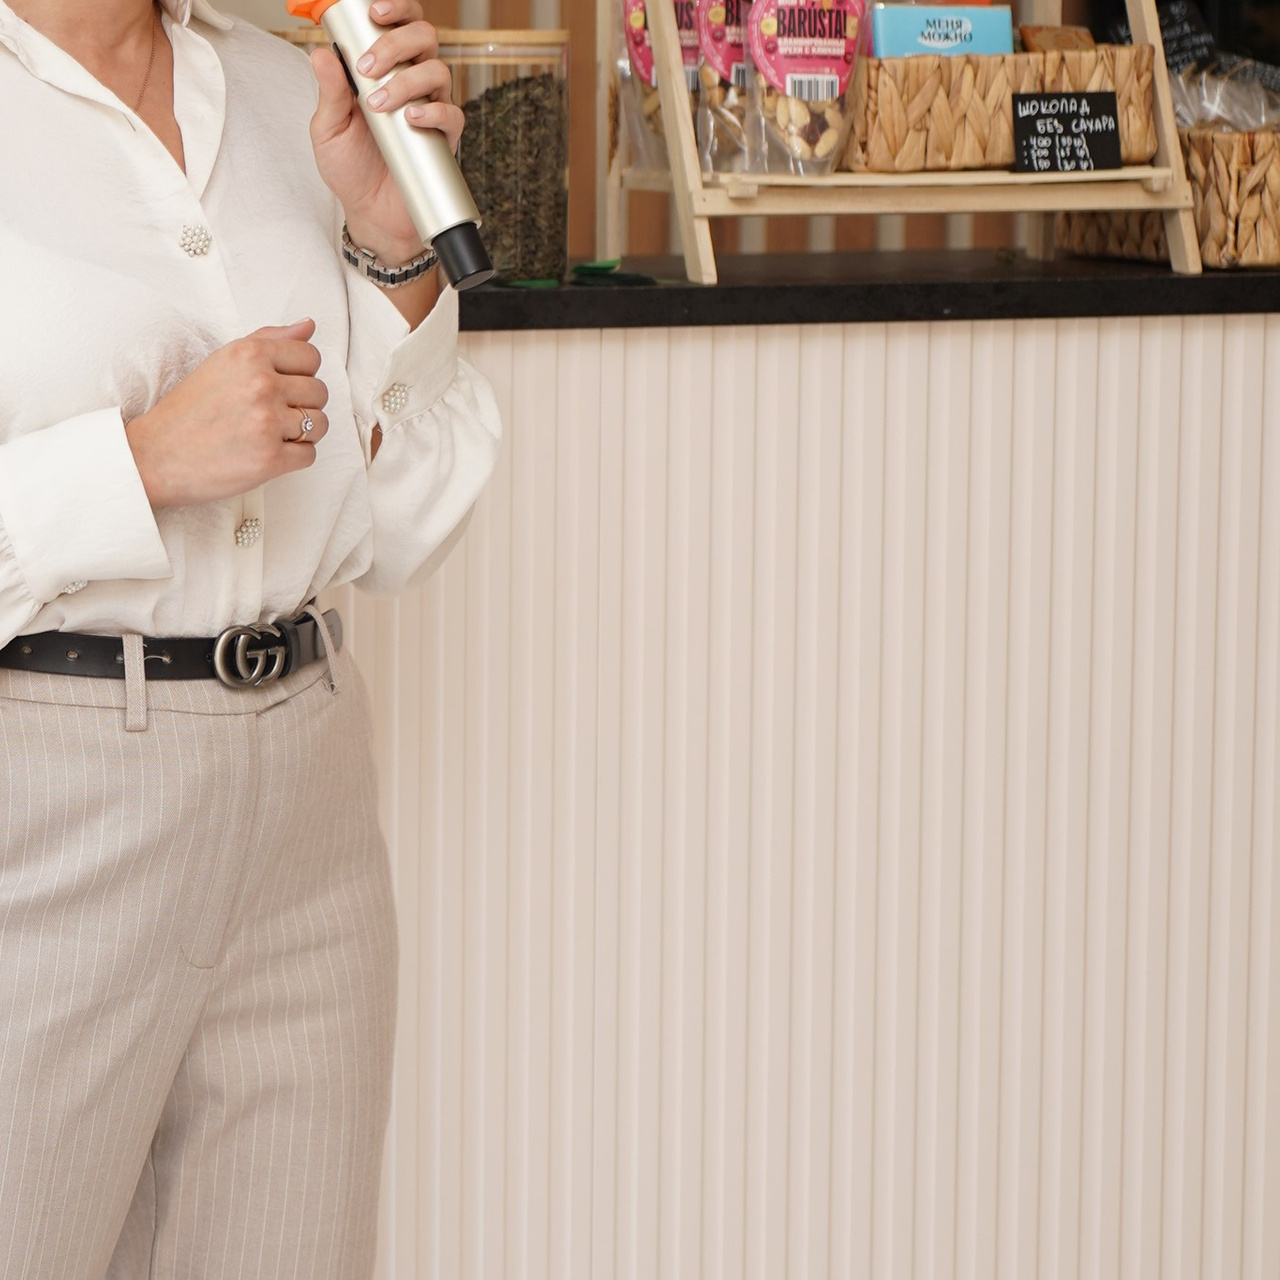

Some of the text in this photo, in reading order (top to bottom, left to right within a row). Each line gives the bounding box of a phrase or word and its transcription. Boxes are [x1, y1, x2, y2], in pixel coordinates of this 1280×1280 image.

[921, 31, 972, 43] МОЖНО
[1018, 97, 1090, 118] ШОКОЛАД
[1036, 114, 1115, 134] БЕЗ САХАРА
